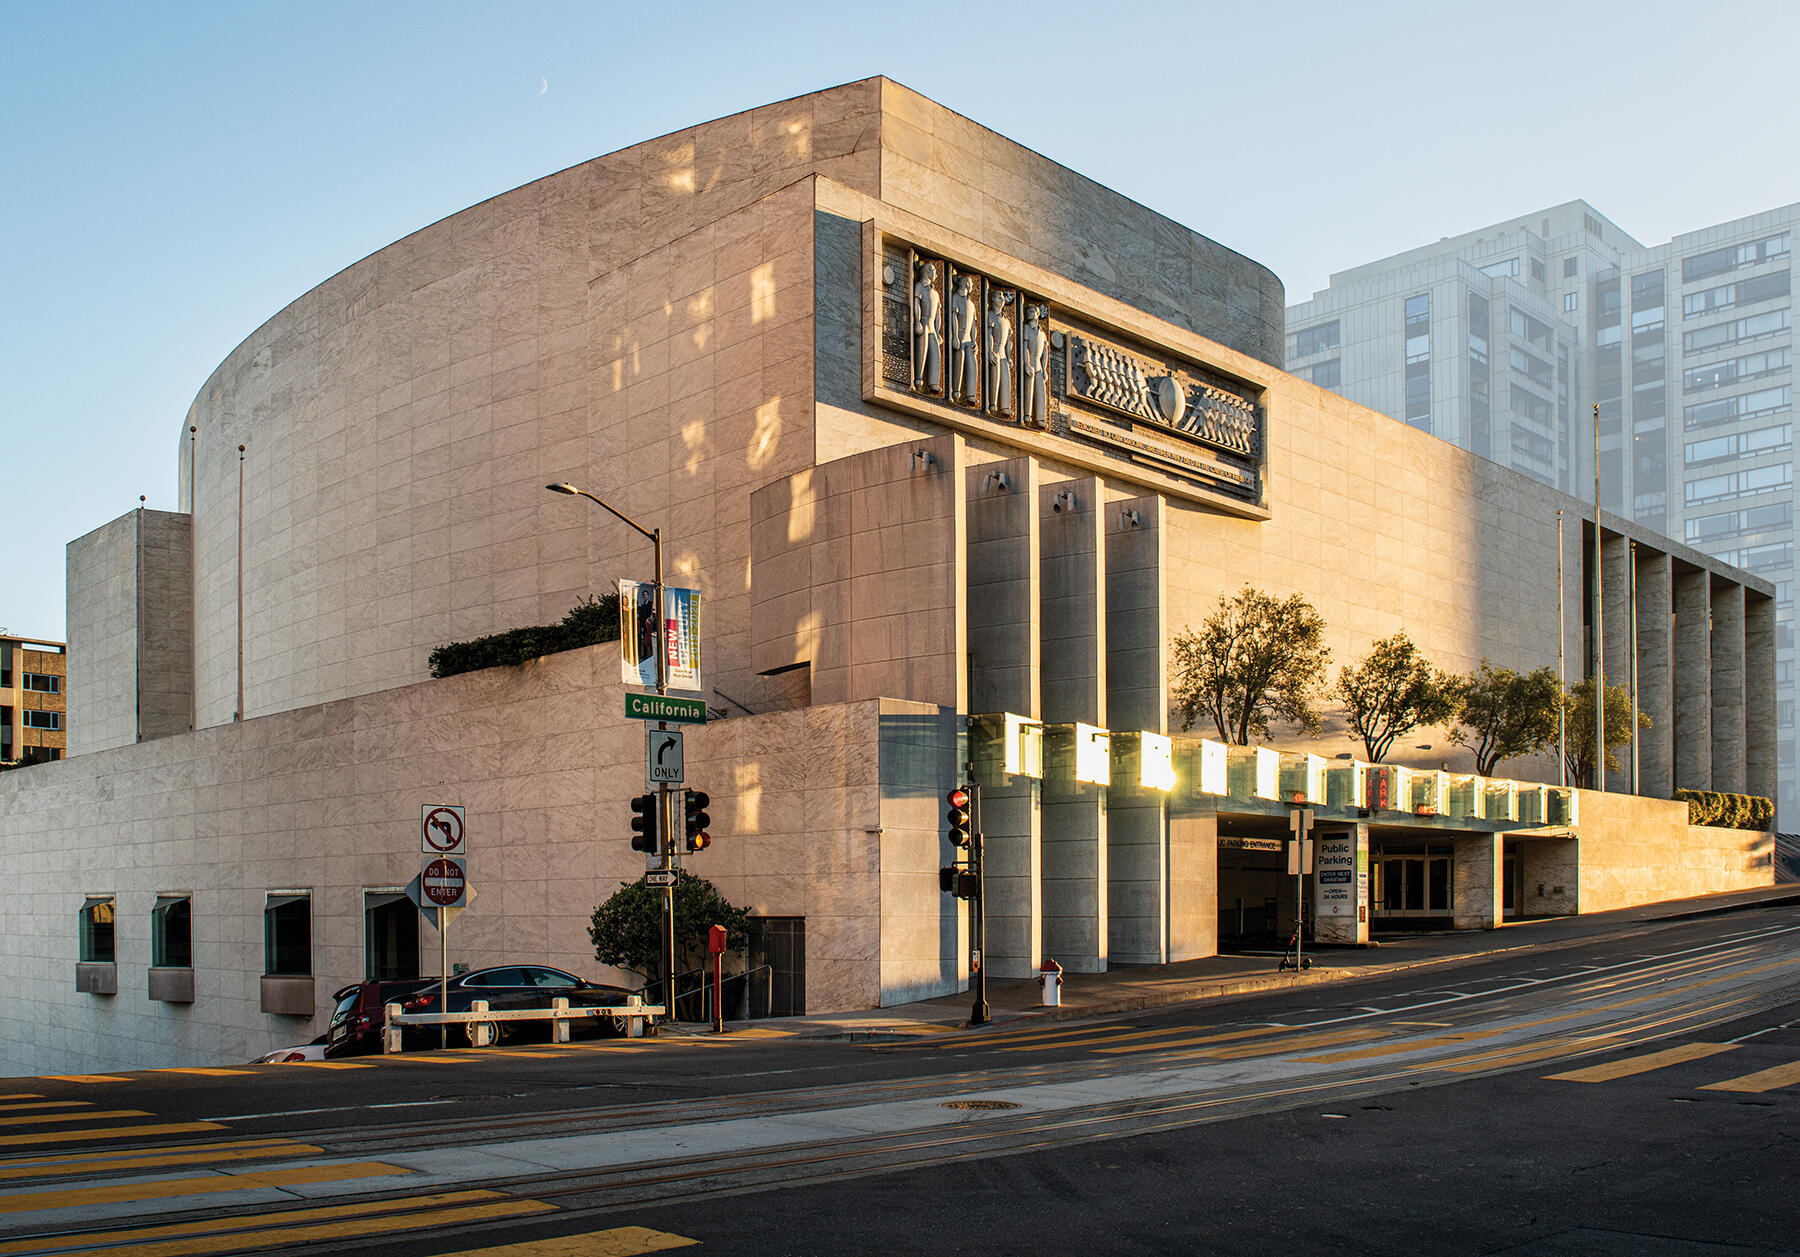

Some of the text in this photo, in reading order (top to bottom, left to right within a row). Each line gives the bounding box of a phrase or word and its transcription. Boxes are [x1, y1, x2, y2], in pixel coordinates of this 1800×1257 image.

[680, 601, 689, 660] CENTURY
[690, 600, 698, 660] 2019-2020
[668, 629, 678, 660] NEW
[632, 699, 700, 718] California
[655, 767, 679, 778] ONLY
[1380, 769, 1388, 808] PARK
[1250, 841, 1276, 849] ENTRANCE
[1321, 844, 1349, 853] Public
[1319, 855, 1352, 865] Parking
[429, 868, 439, 876] DO
[431, 888, 457, 896] ENTER
